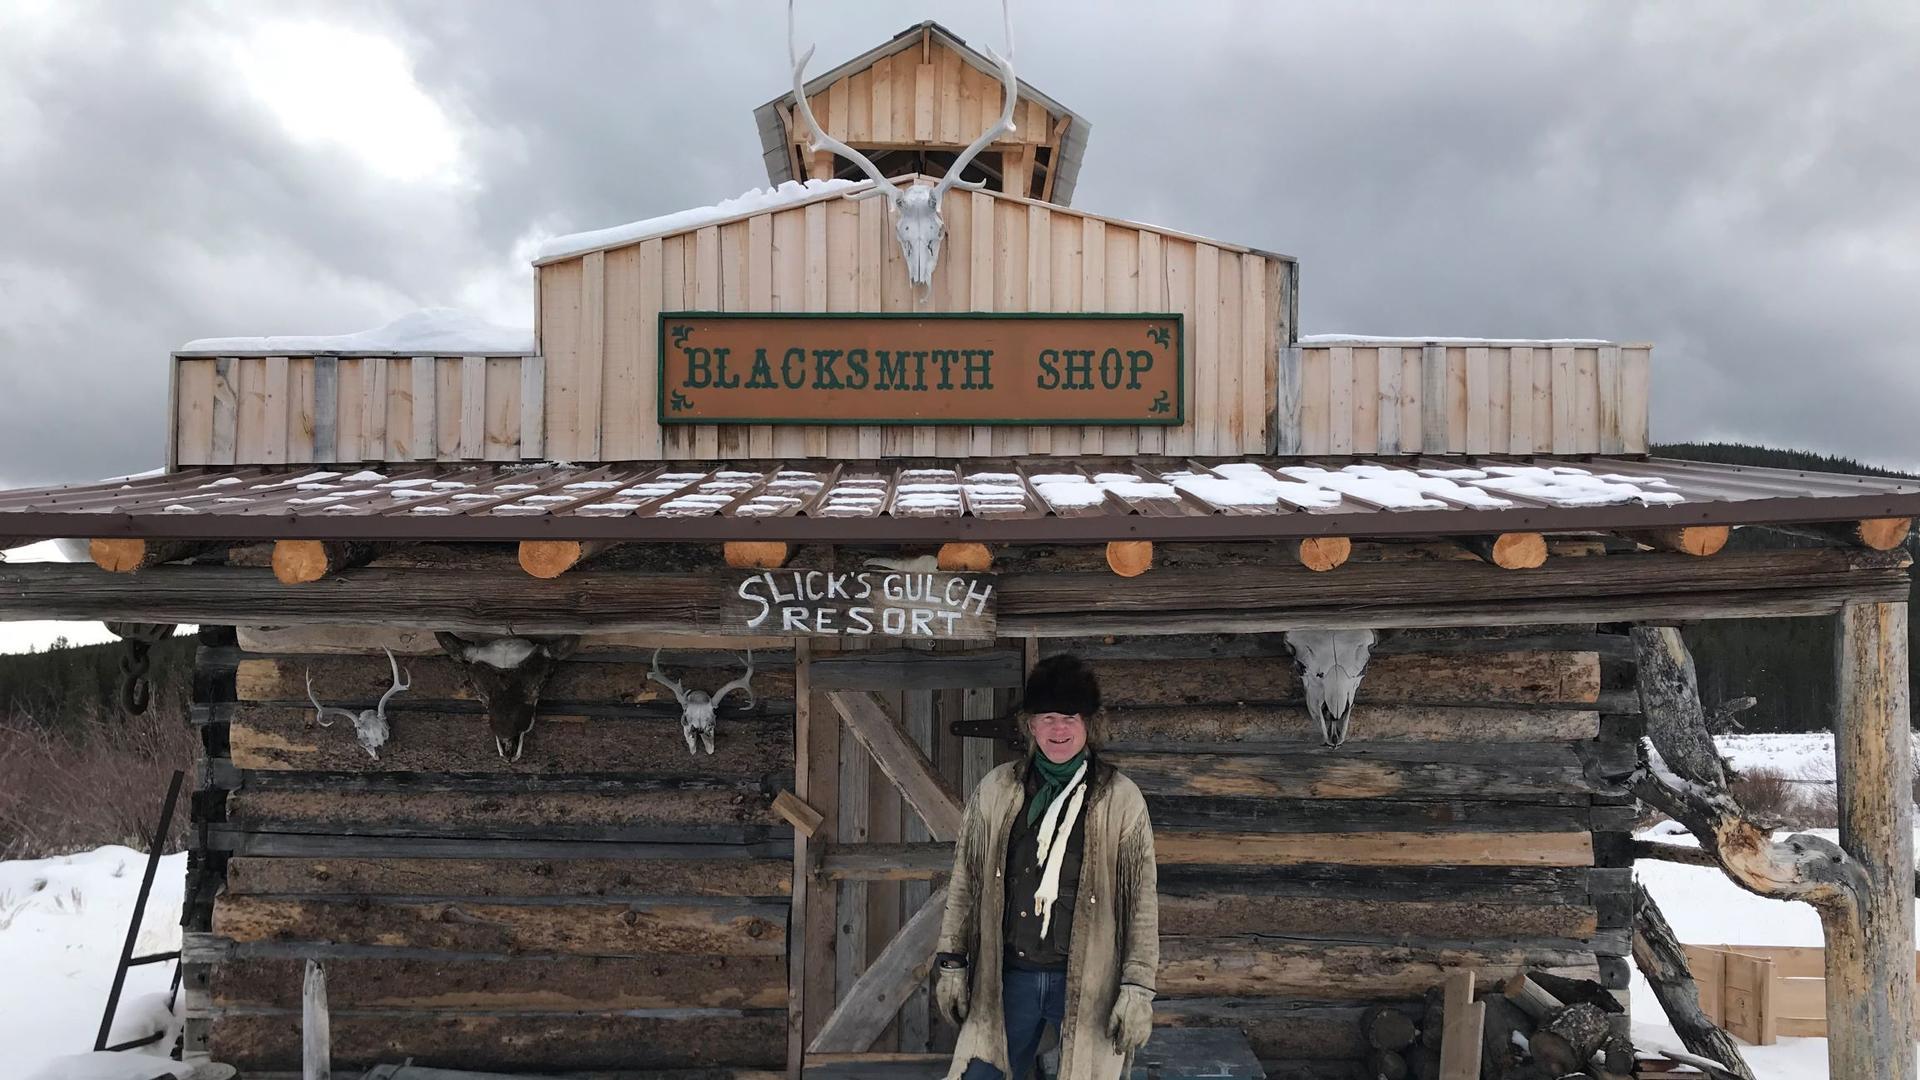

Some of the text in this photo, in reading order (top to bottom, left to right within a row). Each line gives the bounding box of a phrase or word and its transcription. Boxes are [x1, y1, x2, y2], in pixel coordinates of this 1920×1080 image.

[683, 347, 1154, 391] BLACKSMITH SHOP
[738, 570, 993, 627] SLICK'S GULCH
[782, 606, 962, 635] RESORT
